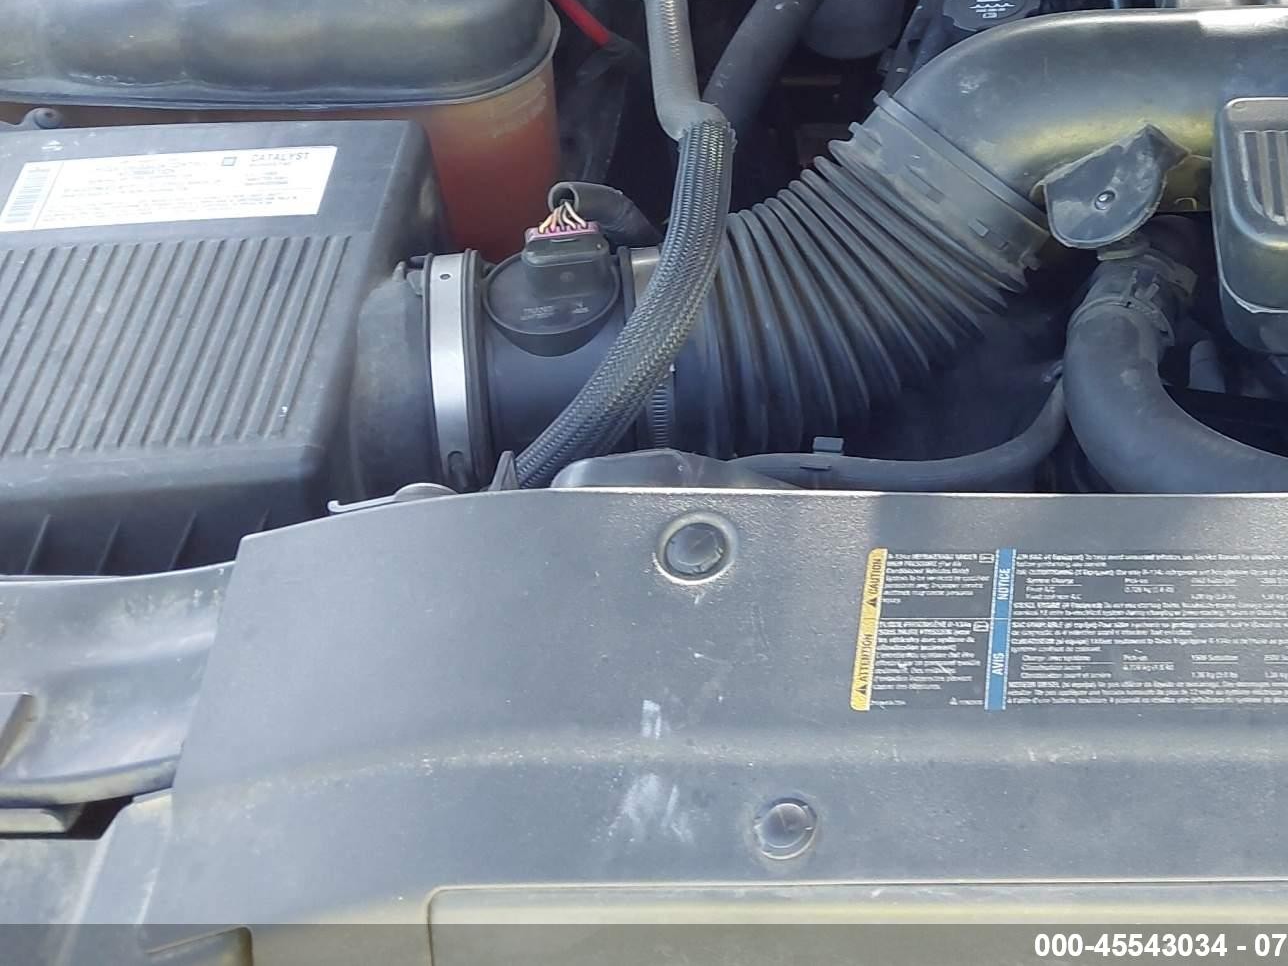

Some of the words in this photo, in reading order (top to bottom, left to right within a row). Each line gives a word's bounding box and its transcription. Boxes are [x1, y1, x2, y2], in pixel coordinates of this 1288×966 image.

[869, 557, 882, 597] CAUTION
[997, 567, 1010, 600] NOTICE
[990, 652, 1004, 676] AVIS
